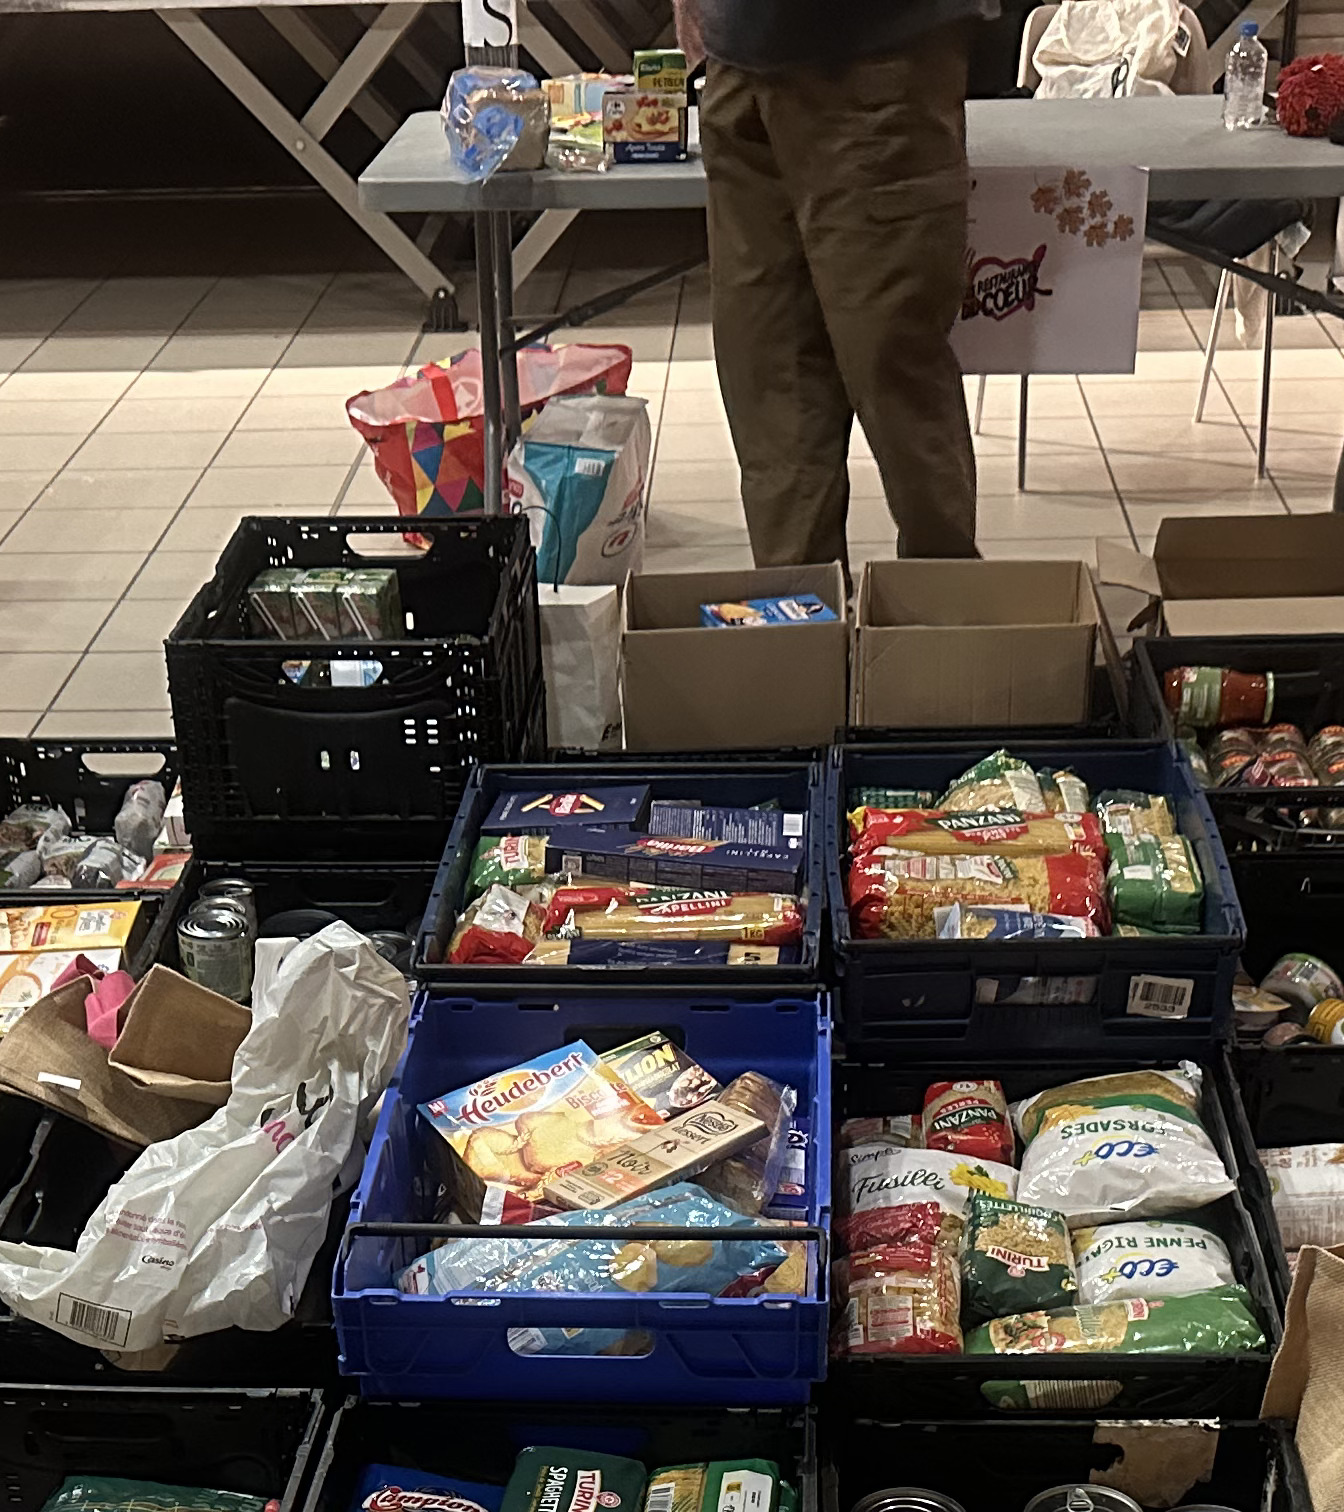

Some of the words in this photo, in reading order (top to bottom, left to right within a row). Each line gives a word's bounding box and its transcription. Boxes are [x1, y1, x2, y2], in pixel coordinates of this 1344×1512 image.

[938, 813, 1021, 831] PANZANI
[624, 1045, 678, 1083] LION
[459, 1051, 585, 1125] Heudebert
[933, 1107, 996, 1132] PANZANI
[142, 1253, 175, 1267] Casino
[988, 1247, 1047, 1270] TURINI
